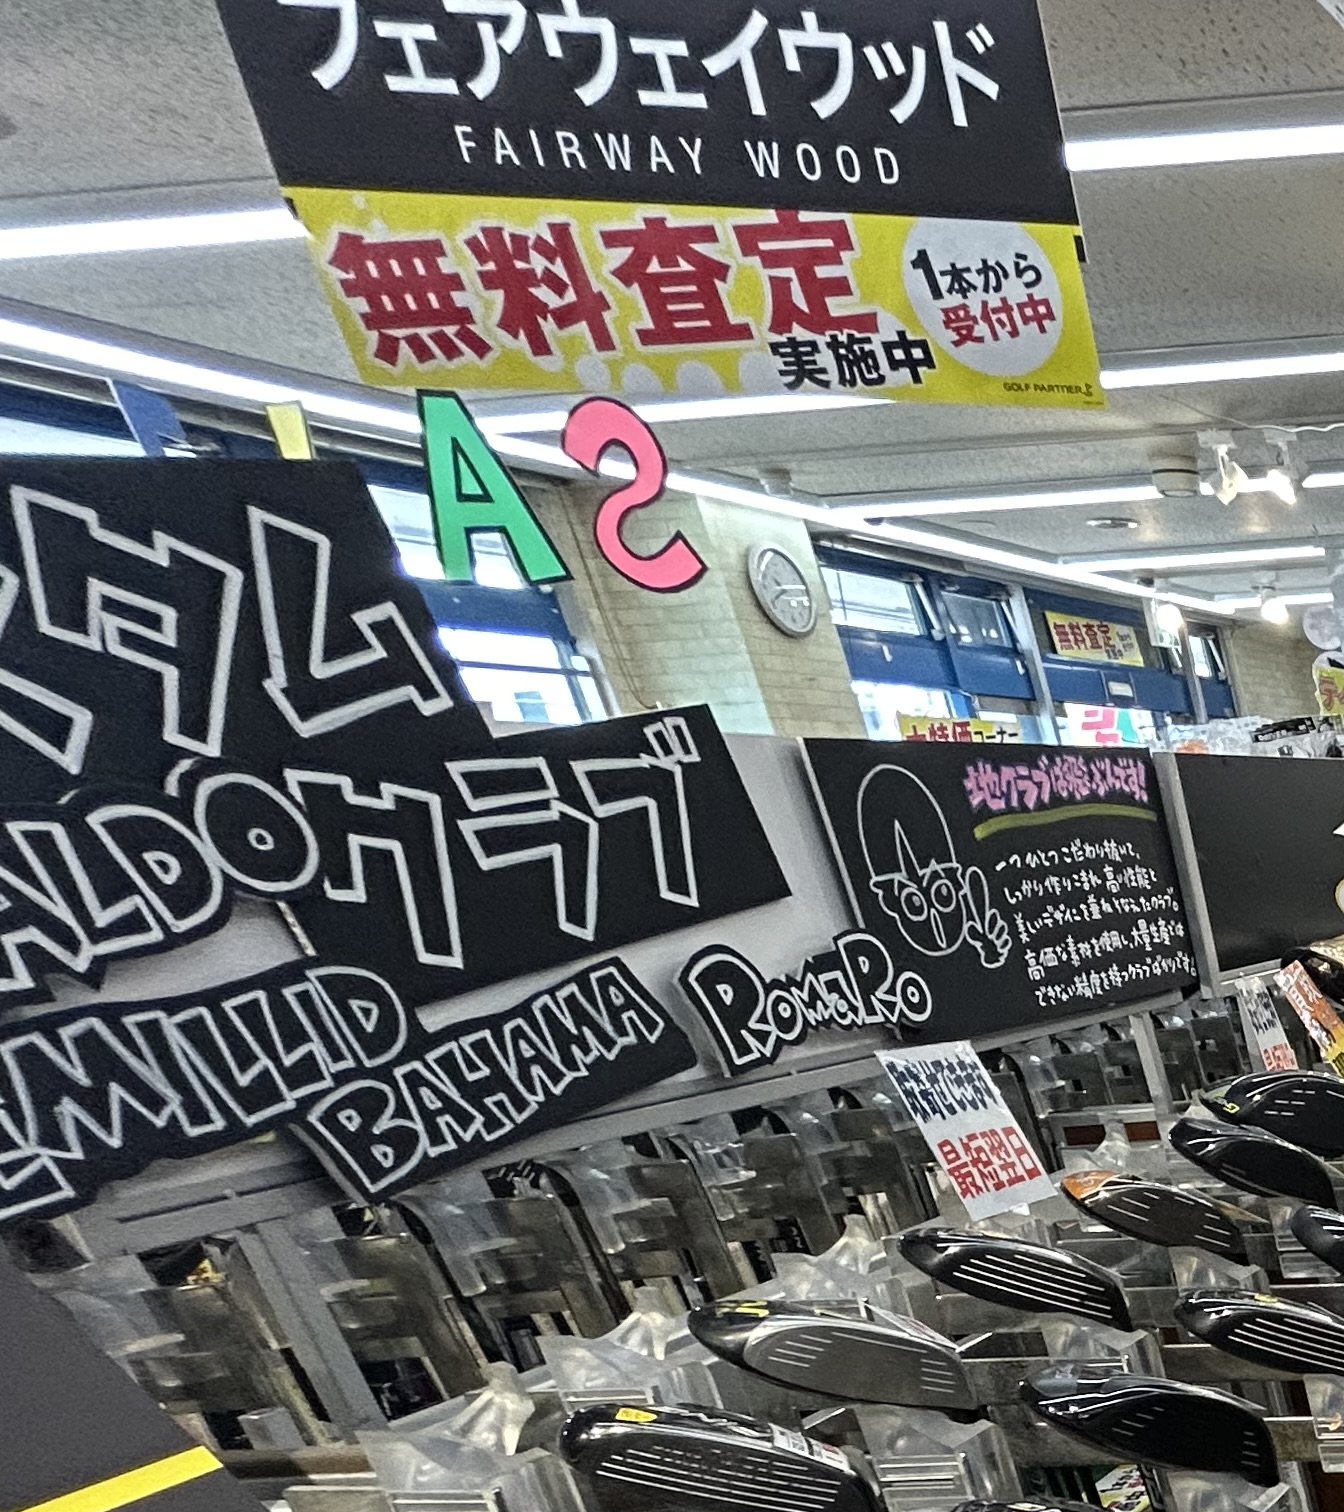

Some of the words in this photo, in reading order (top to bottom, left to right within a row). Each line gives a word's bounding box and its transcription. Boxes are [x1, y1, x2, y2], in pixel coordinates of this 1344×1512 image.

[311, 0, 1000, 127] フェアウェイウッド
[455, 125, 706, 177] FAIRWAY
[746, 140, 902, 186] WOOD
[328, 209, 879, 366] 無料査定
[910, 249, 1044, 302] 1本から
[942, 295, 1058, 348] 受付中
[770, 334, 936, 390] 実施中
[1003, 382, 1031, 394] GOLF
[1053, 622, 1115, 651] 無料査定
[309, 966, 664, 1193] BAHAMA
[937, 1126, 1043, 1200] 最短翌日
